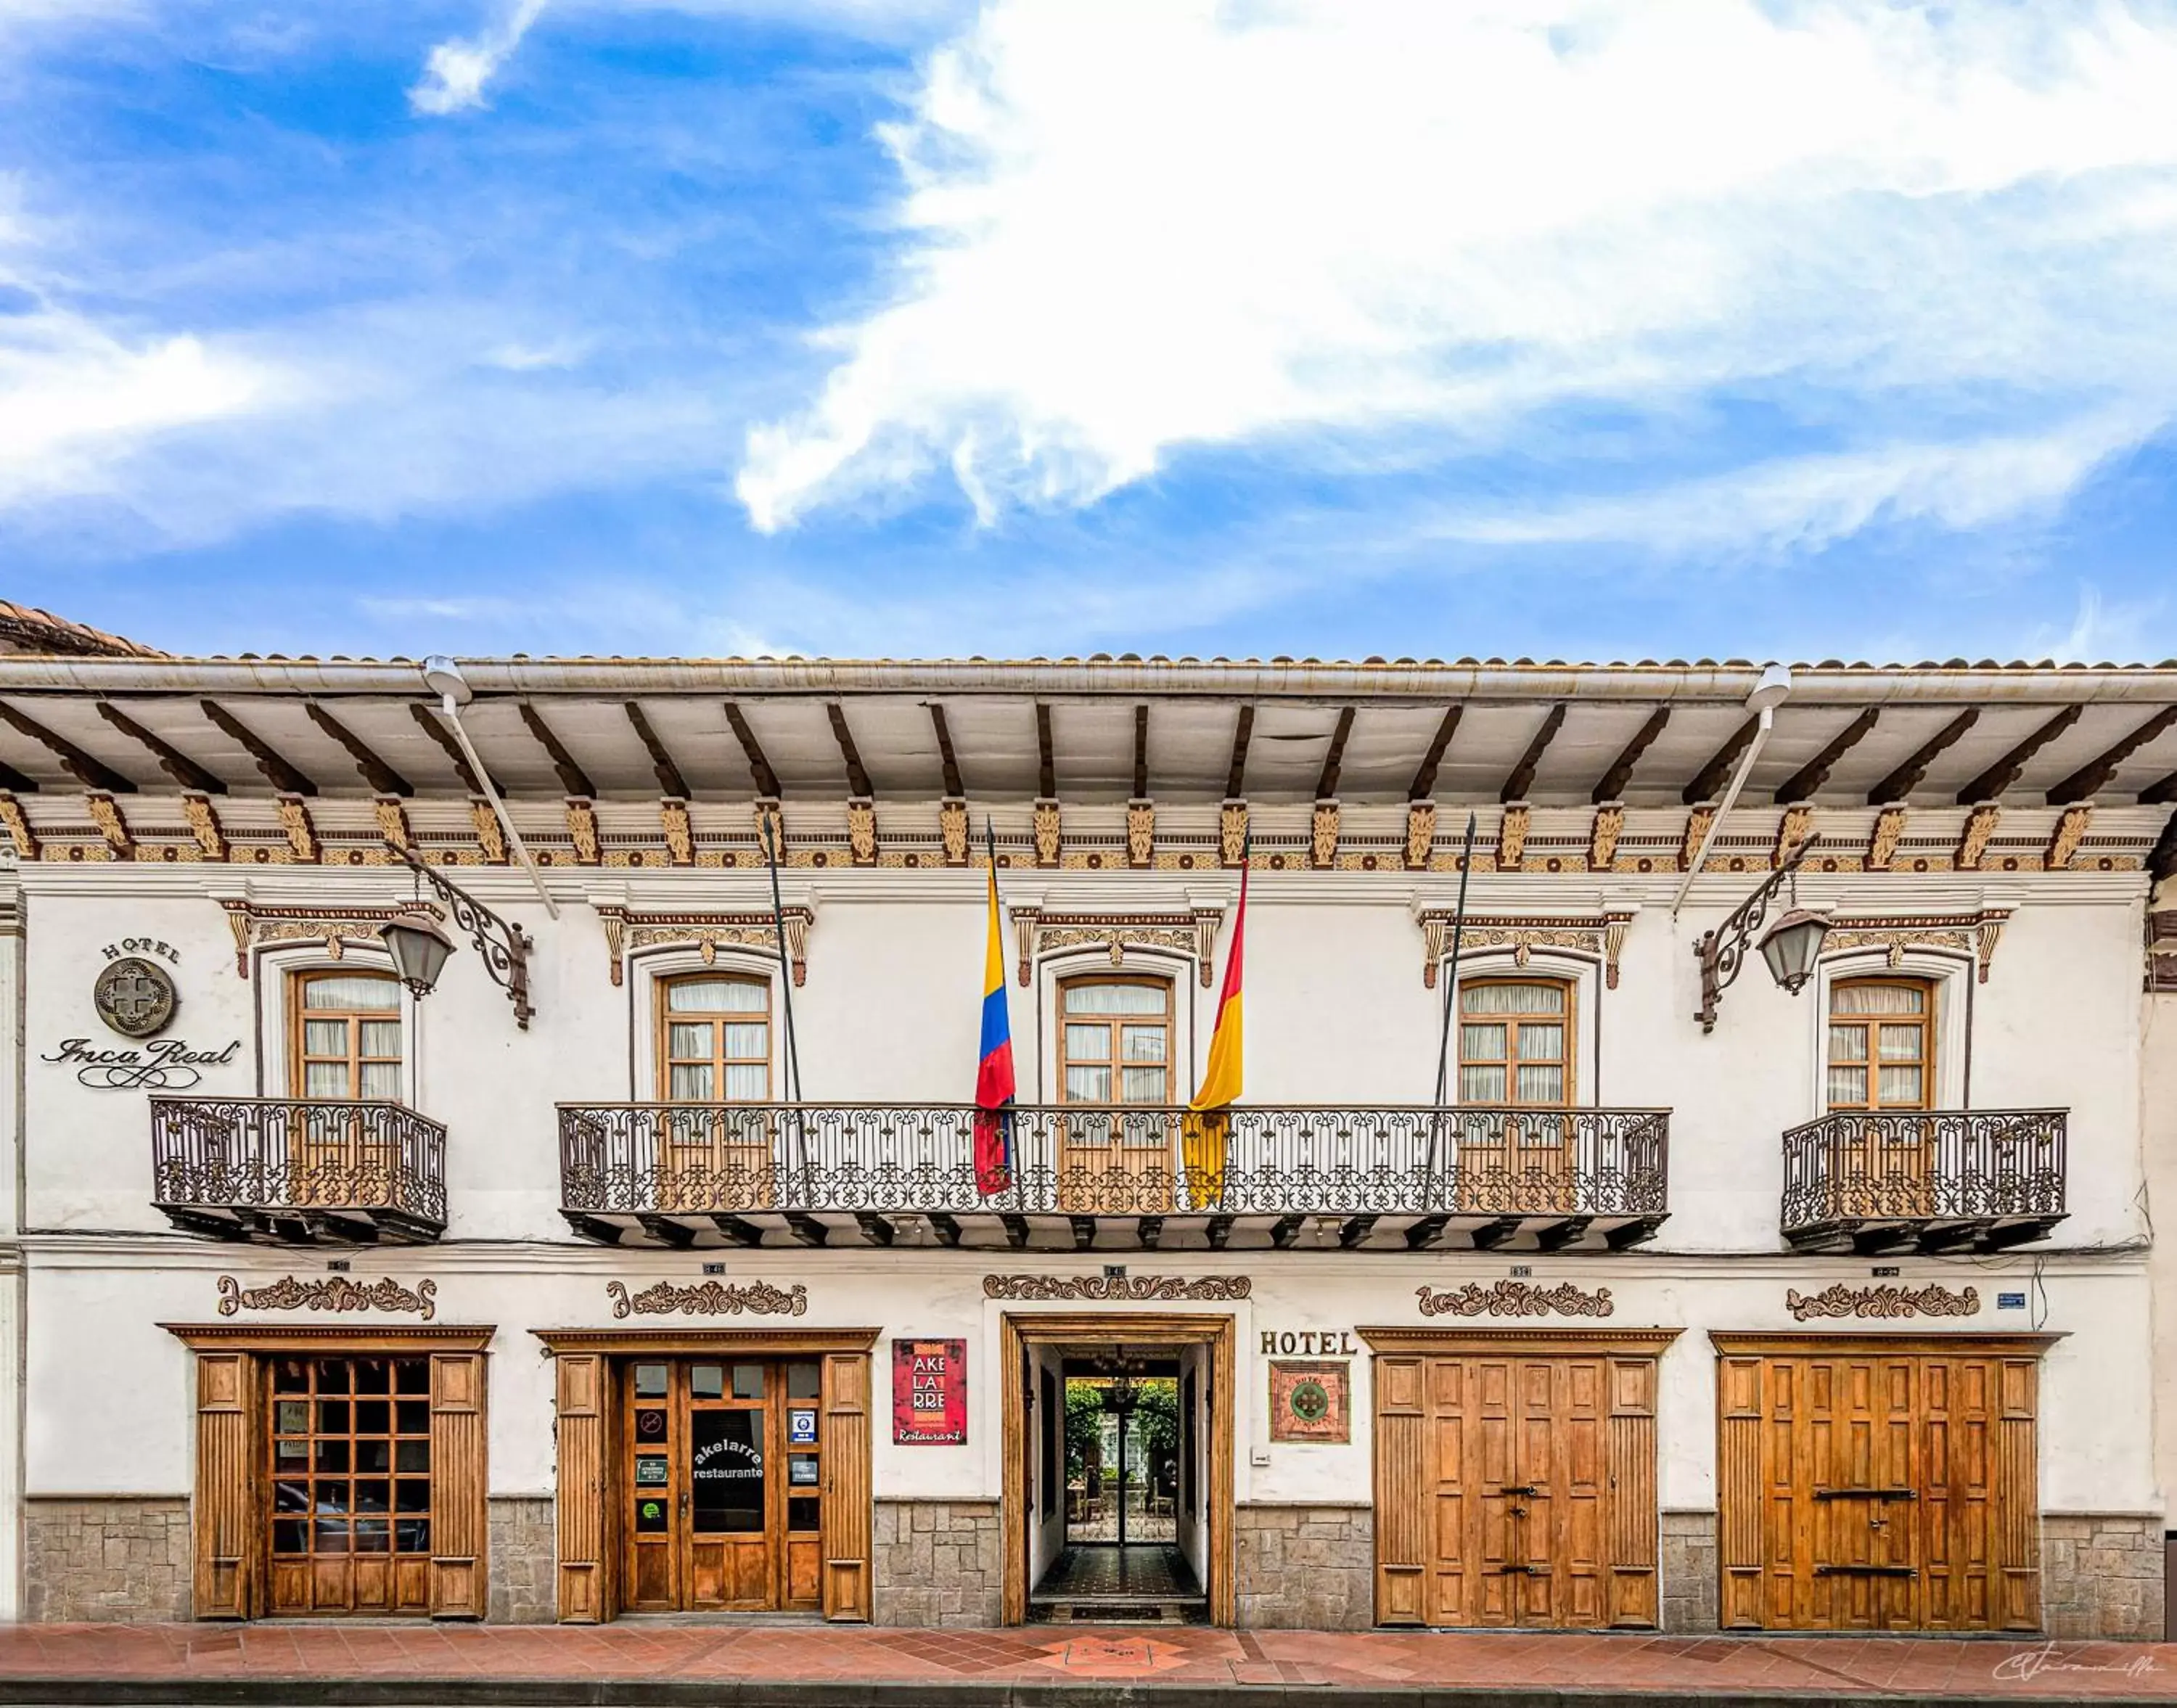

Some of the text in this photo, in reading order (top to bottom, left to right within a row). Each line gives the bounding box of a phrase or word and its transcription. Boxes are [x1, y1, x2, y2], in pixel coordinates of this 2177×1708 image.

[102, 937, 181, 964] HOTEL
[41, 1038, 241, 1064] Inca Real
[1260, 1331, 1358, 1355] HOTEL
[913, 1358, 945, 1371] AKE
[913, 1376, 938, 1389] LA
[914, 1392, 945, 1408] RRE
[899, 1429, 961, 1442] Restaurant
[694, 1439, 761, 1465] akelarre
[694, 1468, 763, 1479] restaurante
